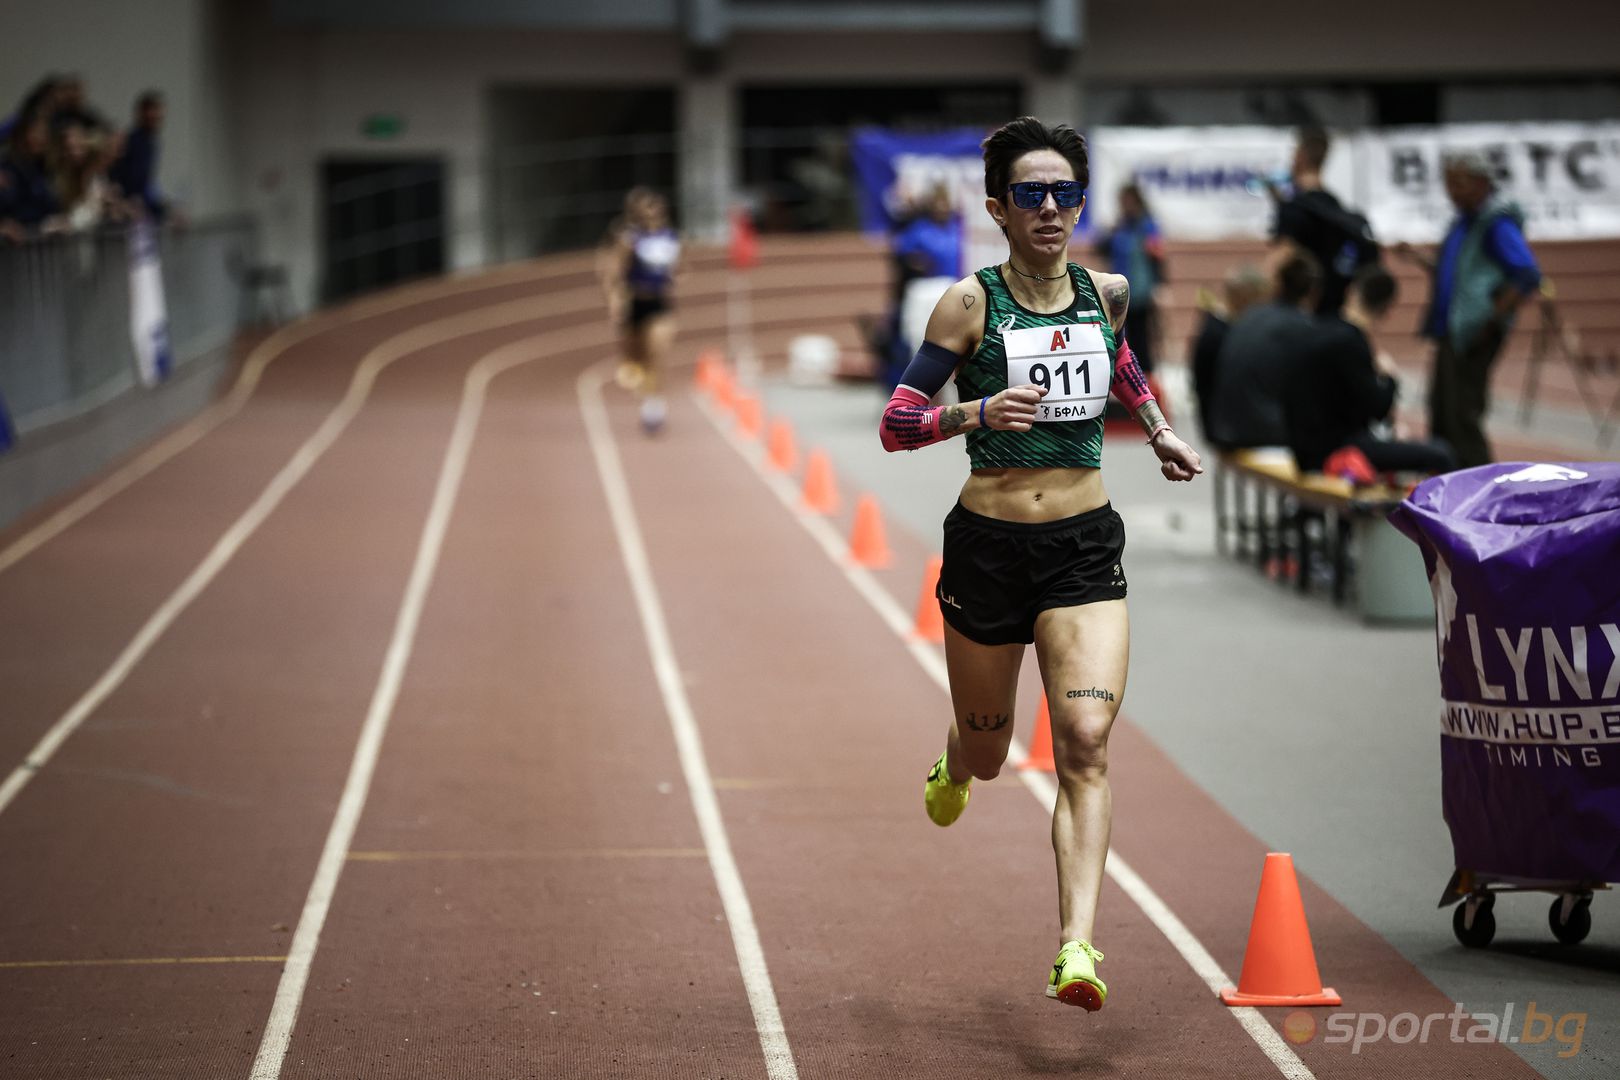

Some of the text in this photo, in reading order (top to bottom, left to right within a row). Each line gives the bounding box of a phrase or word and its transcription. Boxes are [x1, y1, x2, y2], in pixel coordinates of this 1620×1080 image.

[1050, 327, 1070, 351] A1
[1029, 360, 1091, 396] 911
[1054, 405, 1087, 418] БФЛА
[1466, 613, 1620, 701] LYNX
[1484, 743, 1602, 767] TIMING
